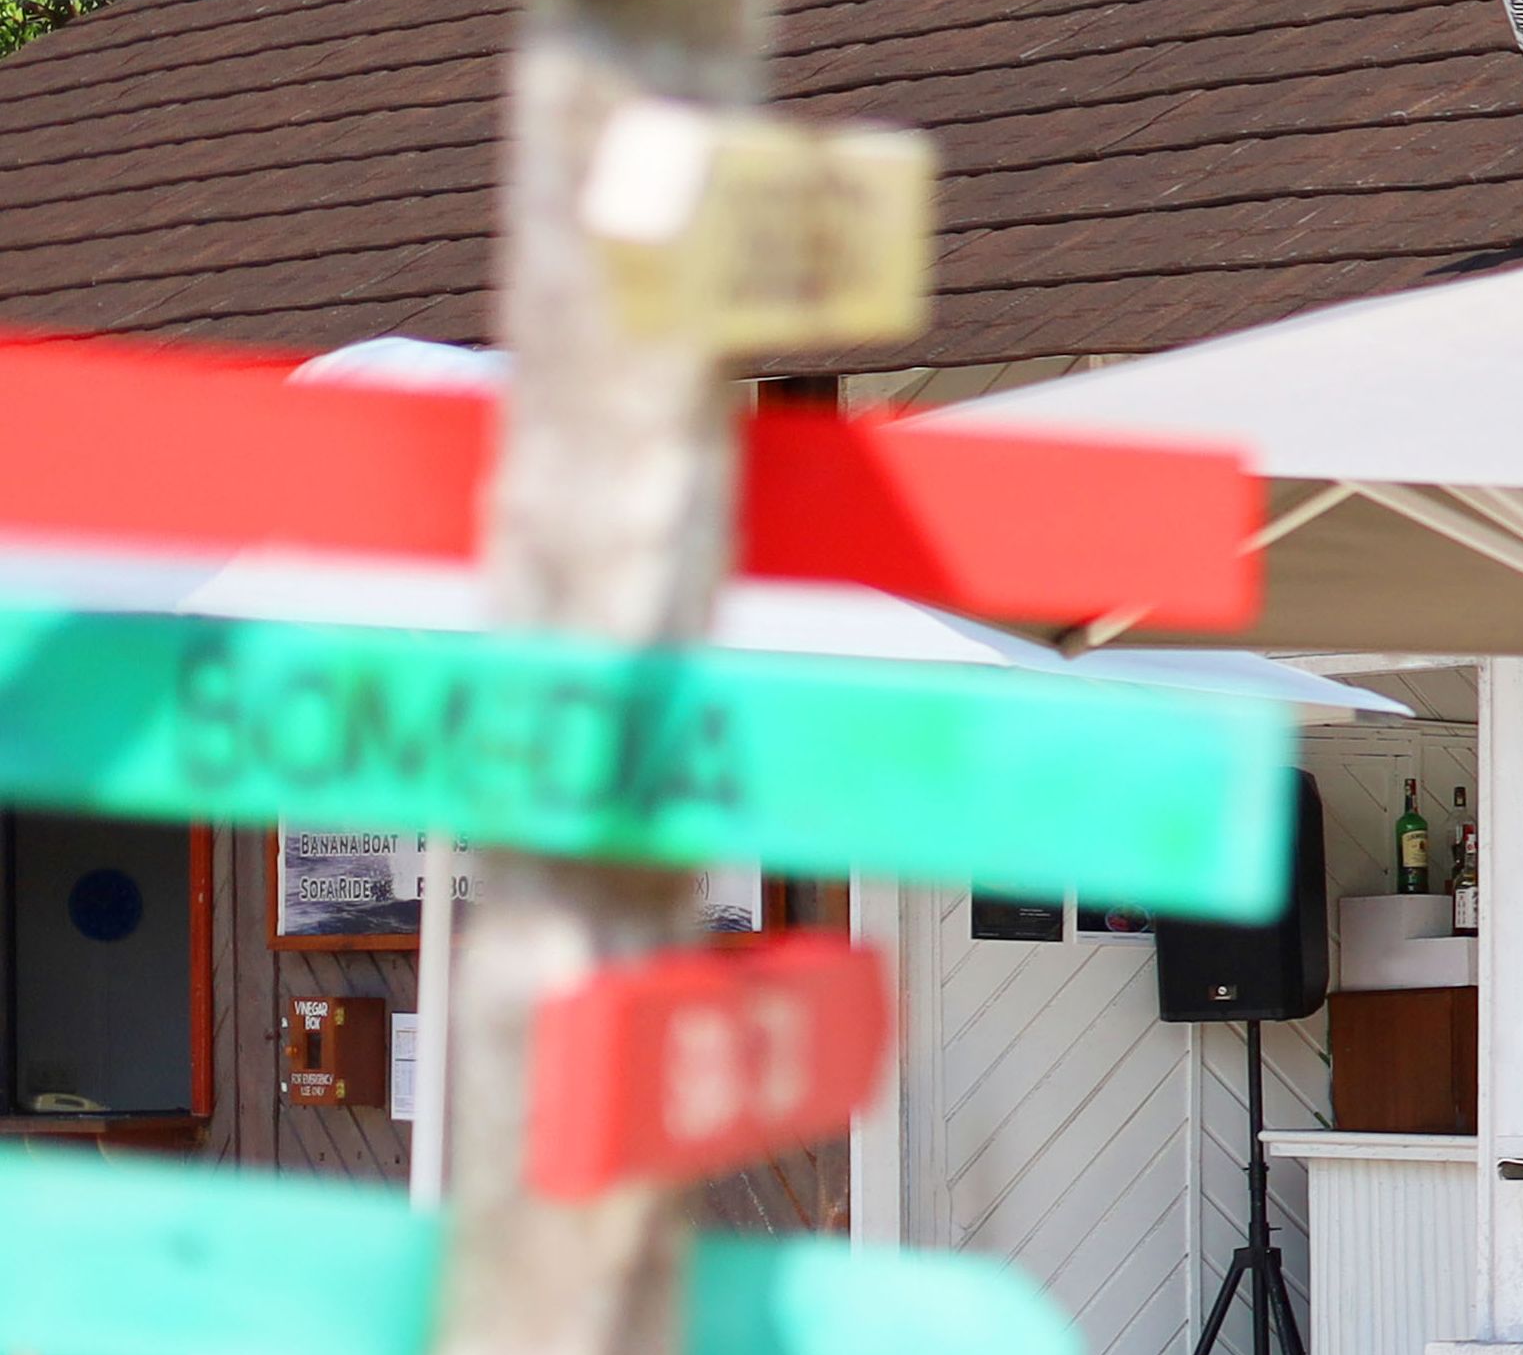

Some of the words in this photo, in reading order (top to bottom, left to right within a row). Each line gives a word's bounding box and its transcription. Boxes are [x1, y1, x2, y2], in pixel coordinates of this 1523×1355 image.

[301, 834, 359, 855] BANANA
[363, 833, 399, 854] BOAT
[300, 877, 338, 899] SOFA
[339, 876, 371, 899] RIDE
[294, 1001, 328, 1017] VINEGAR
[305, 1016, 321, 1030] BOX
